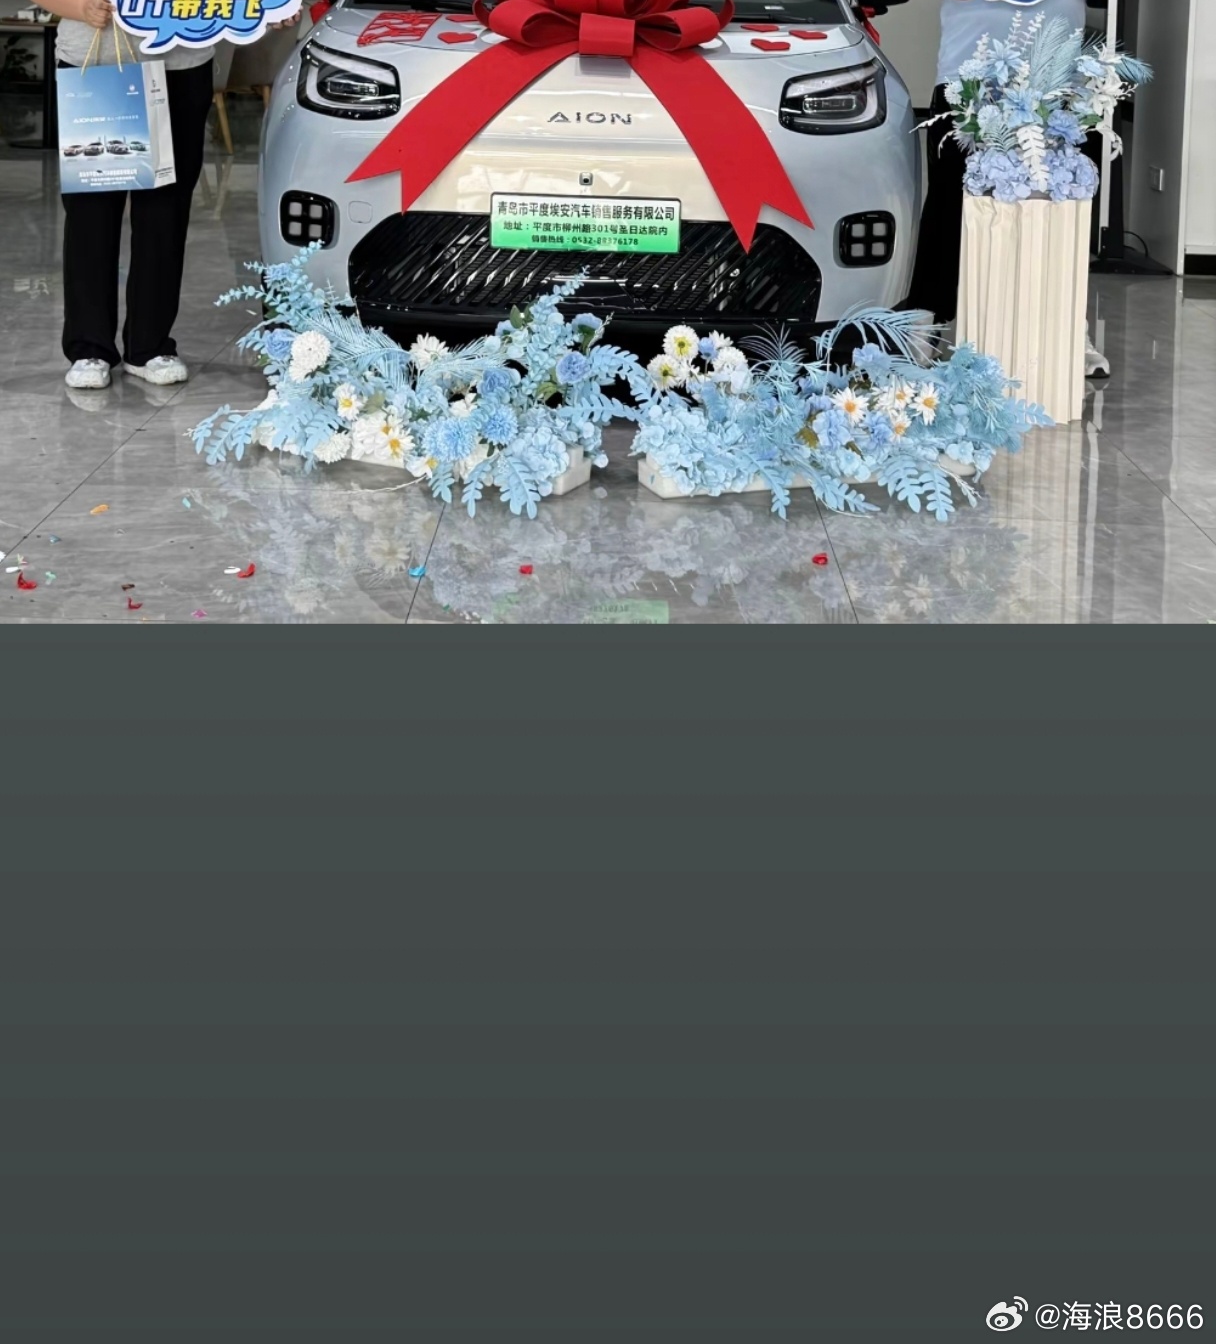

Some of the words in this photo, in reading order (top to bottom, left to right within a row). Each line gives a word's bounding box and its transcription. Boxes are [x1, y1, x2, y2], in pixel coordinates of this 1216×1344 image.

[547, 111, 632, 125] AION
[497, 201, 675, 221] 青岛市平度埃安汽车销售服务有限公司
